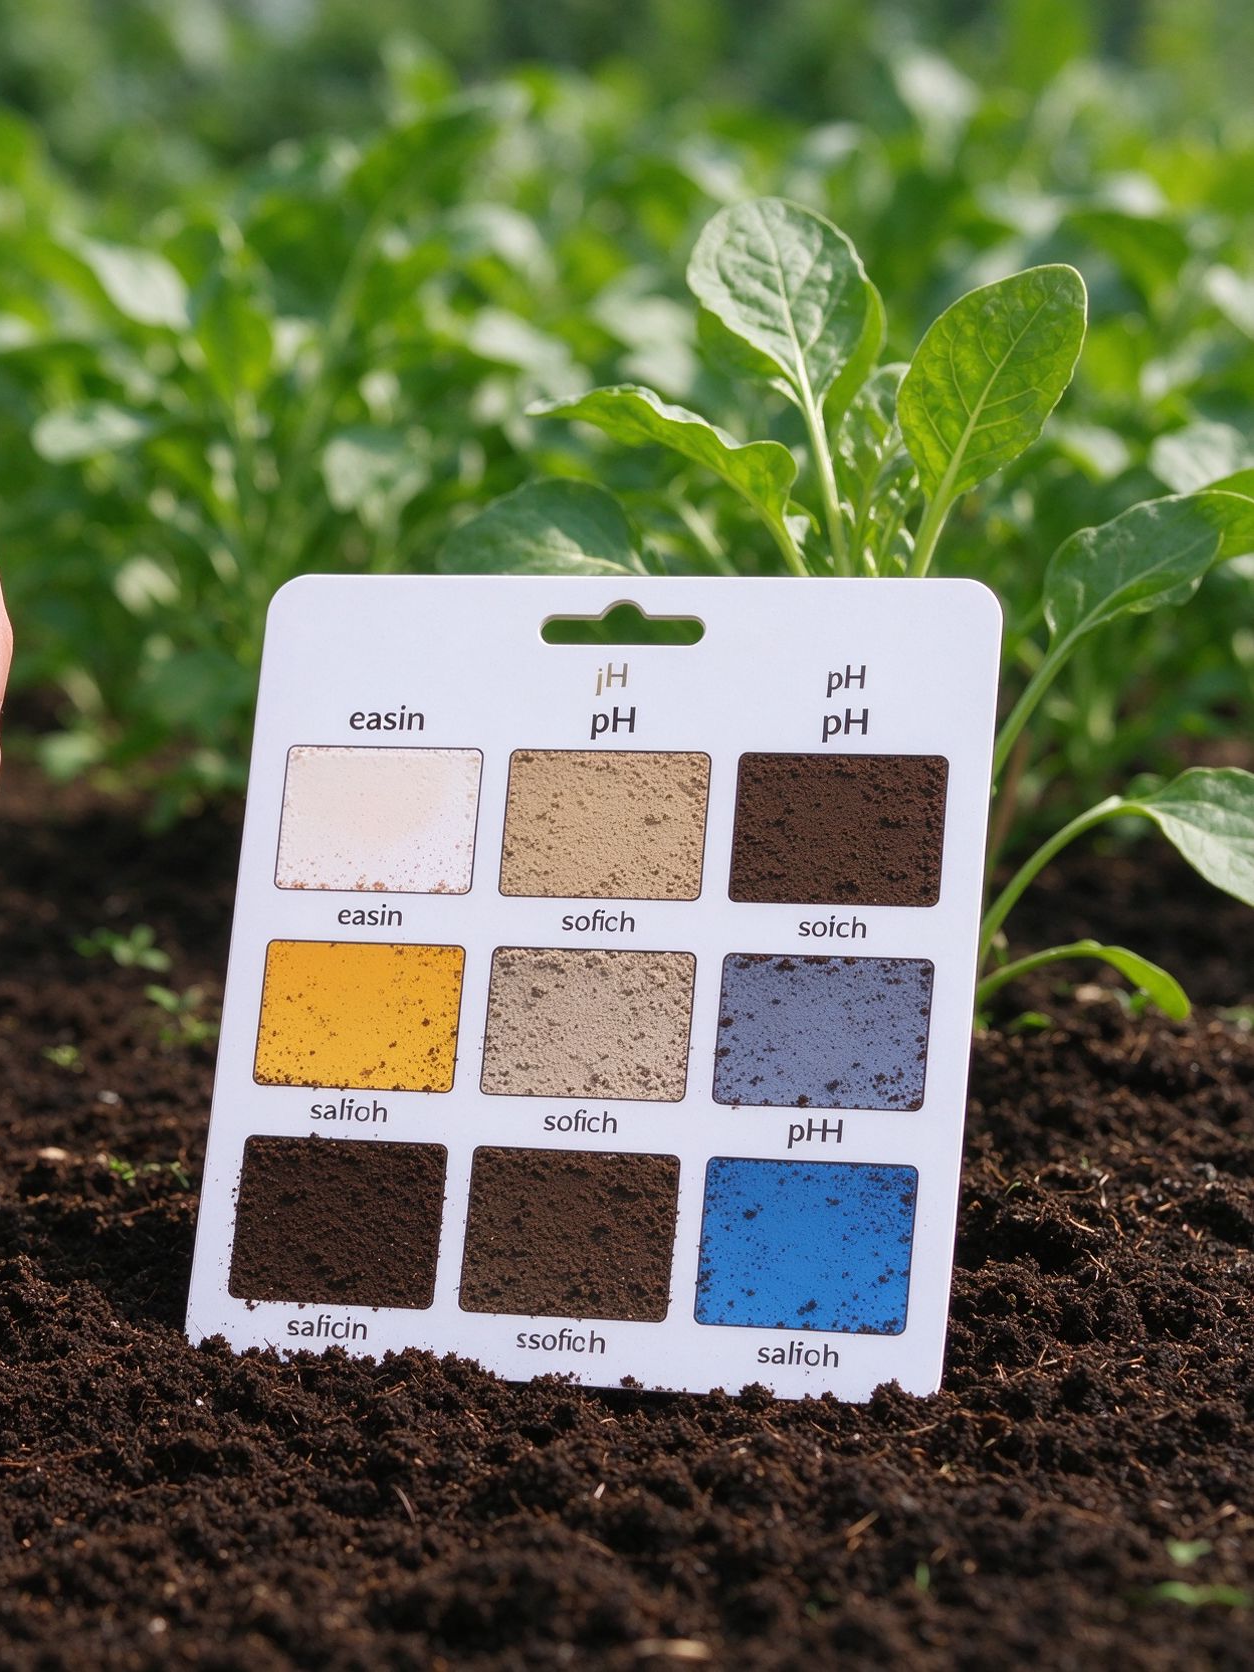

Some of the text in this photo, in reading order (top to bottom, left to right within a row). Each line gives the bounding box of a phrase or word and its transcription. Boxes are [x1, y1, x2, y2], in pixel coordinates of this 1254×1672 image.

[826, 664, 867, 697] pH
[349, 704, 425, 731] easin
[589, 706, 637, 741] pH
[821, 707, 869, 744] pH
[337, 903, 403, 927] easin
[561, 908, 636, 933] sofich
[797, 914, 868, 939] soich
[542, 1108, 618, 1135] sofich
[515, 1327, 606, 1355] ssofich
